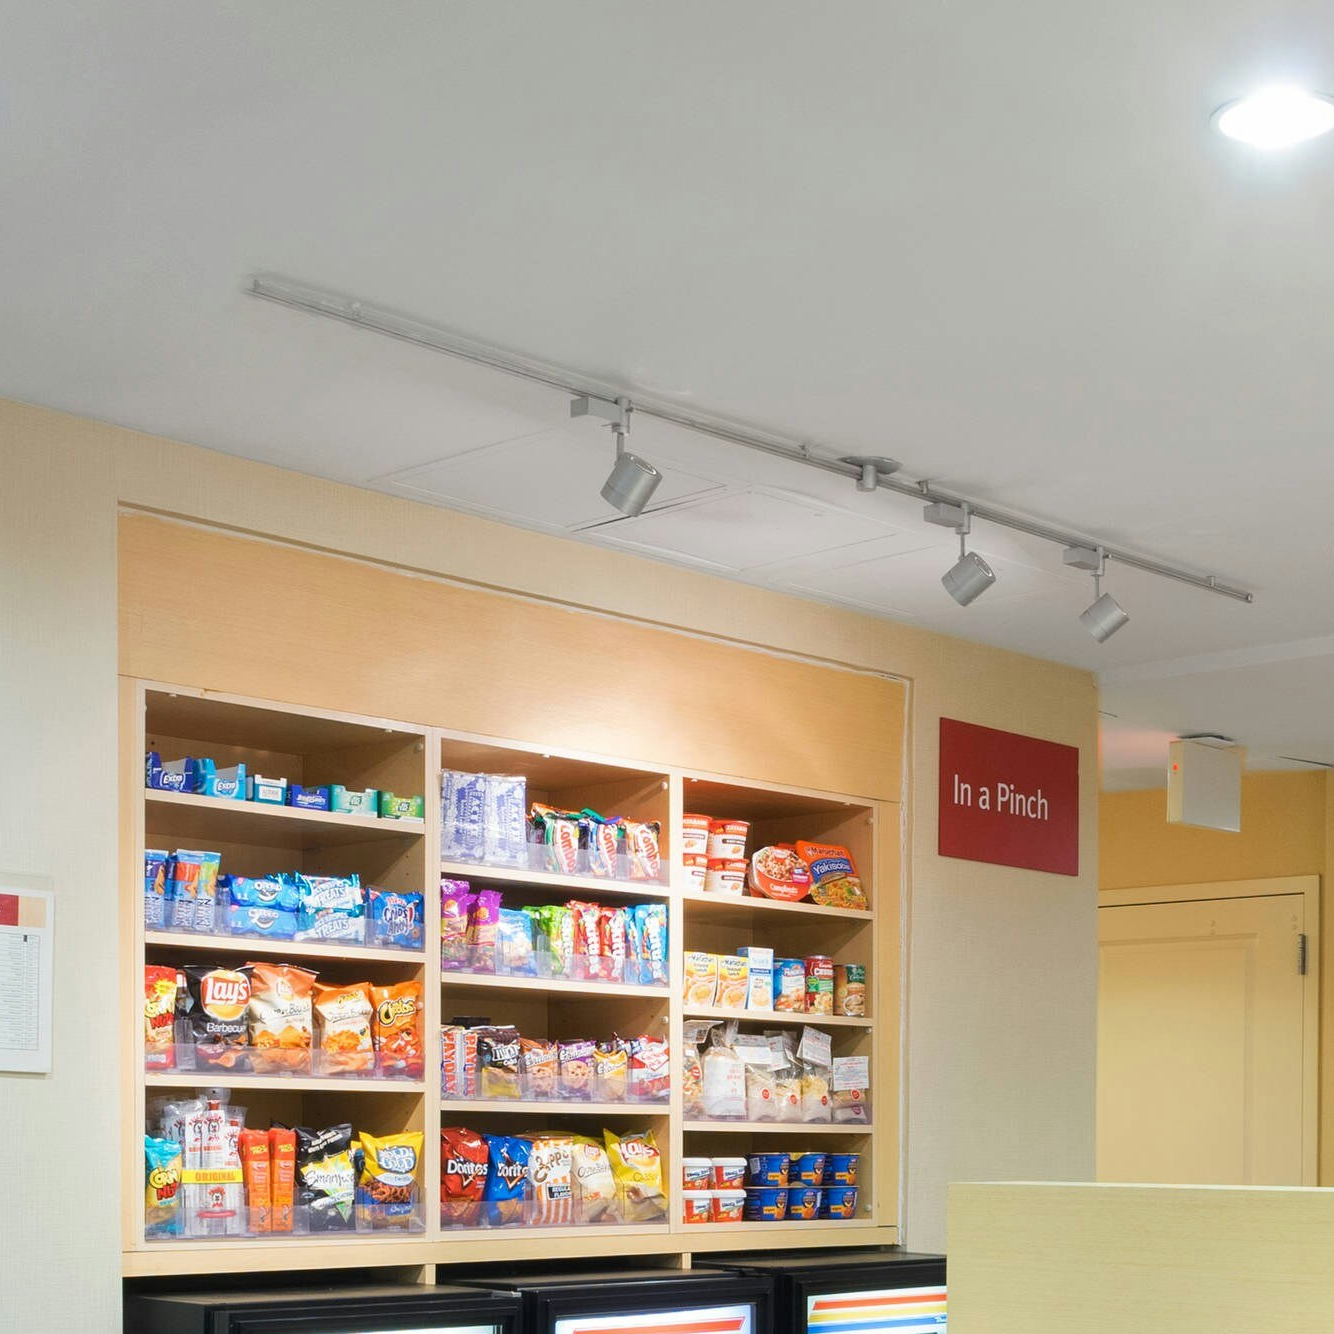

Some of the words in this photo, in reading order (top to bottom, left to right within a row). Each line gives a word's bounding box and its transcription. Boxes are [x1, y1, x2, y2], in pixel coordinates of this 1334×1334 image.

[954, 773, 972, 807] In
[978, 786, 991, 811] a
[997, 782, 1049, 821] Pinch
[207, 1023, 247, 1033] Barbecue
[443, 1031, 457, 1094] PAYDAY
[447, 1159, 488, 1176] Doritos
[195, 1172, 236, 1182] ORIGINAL
